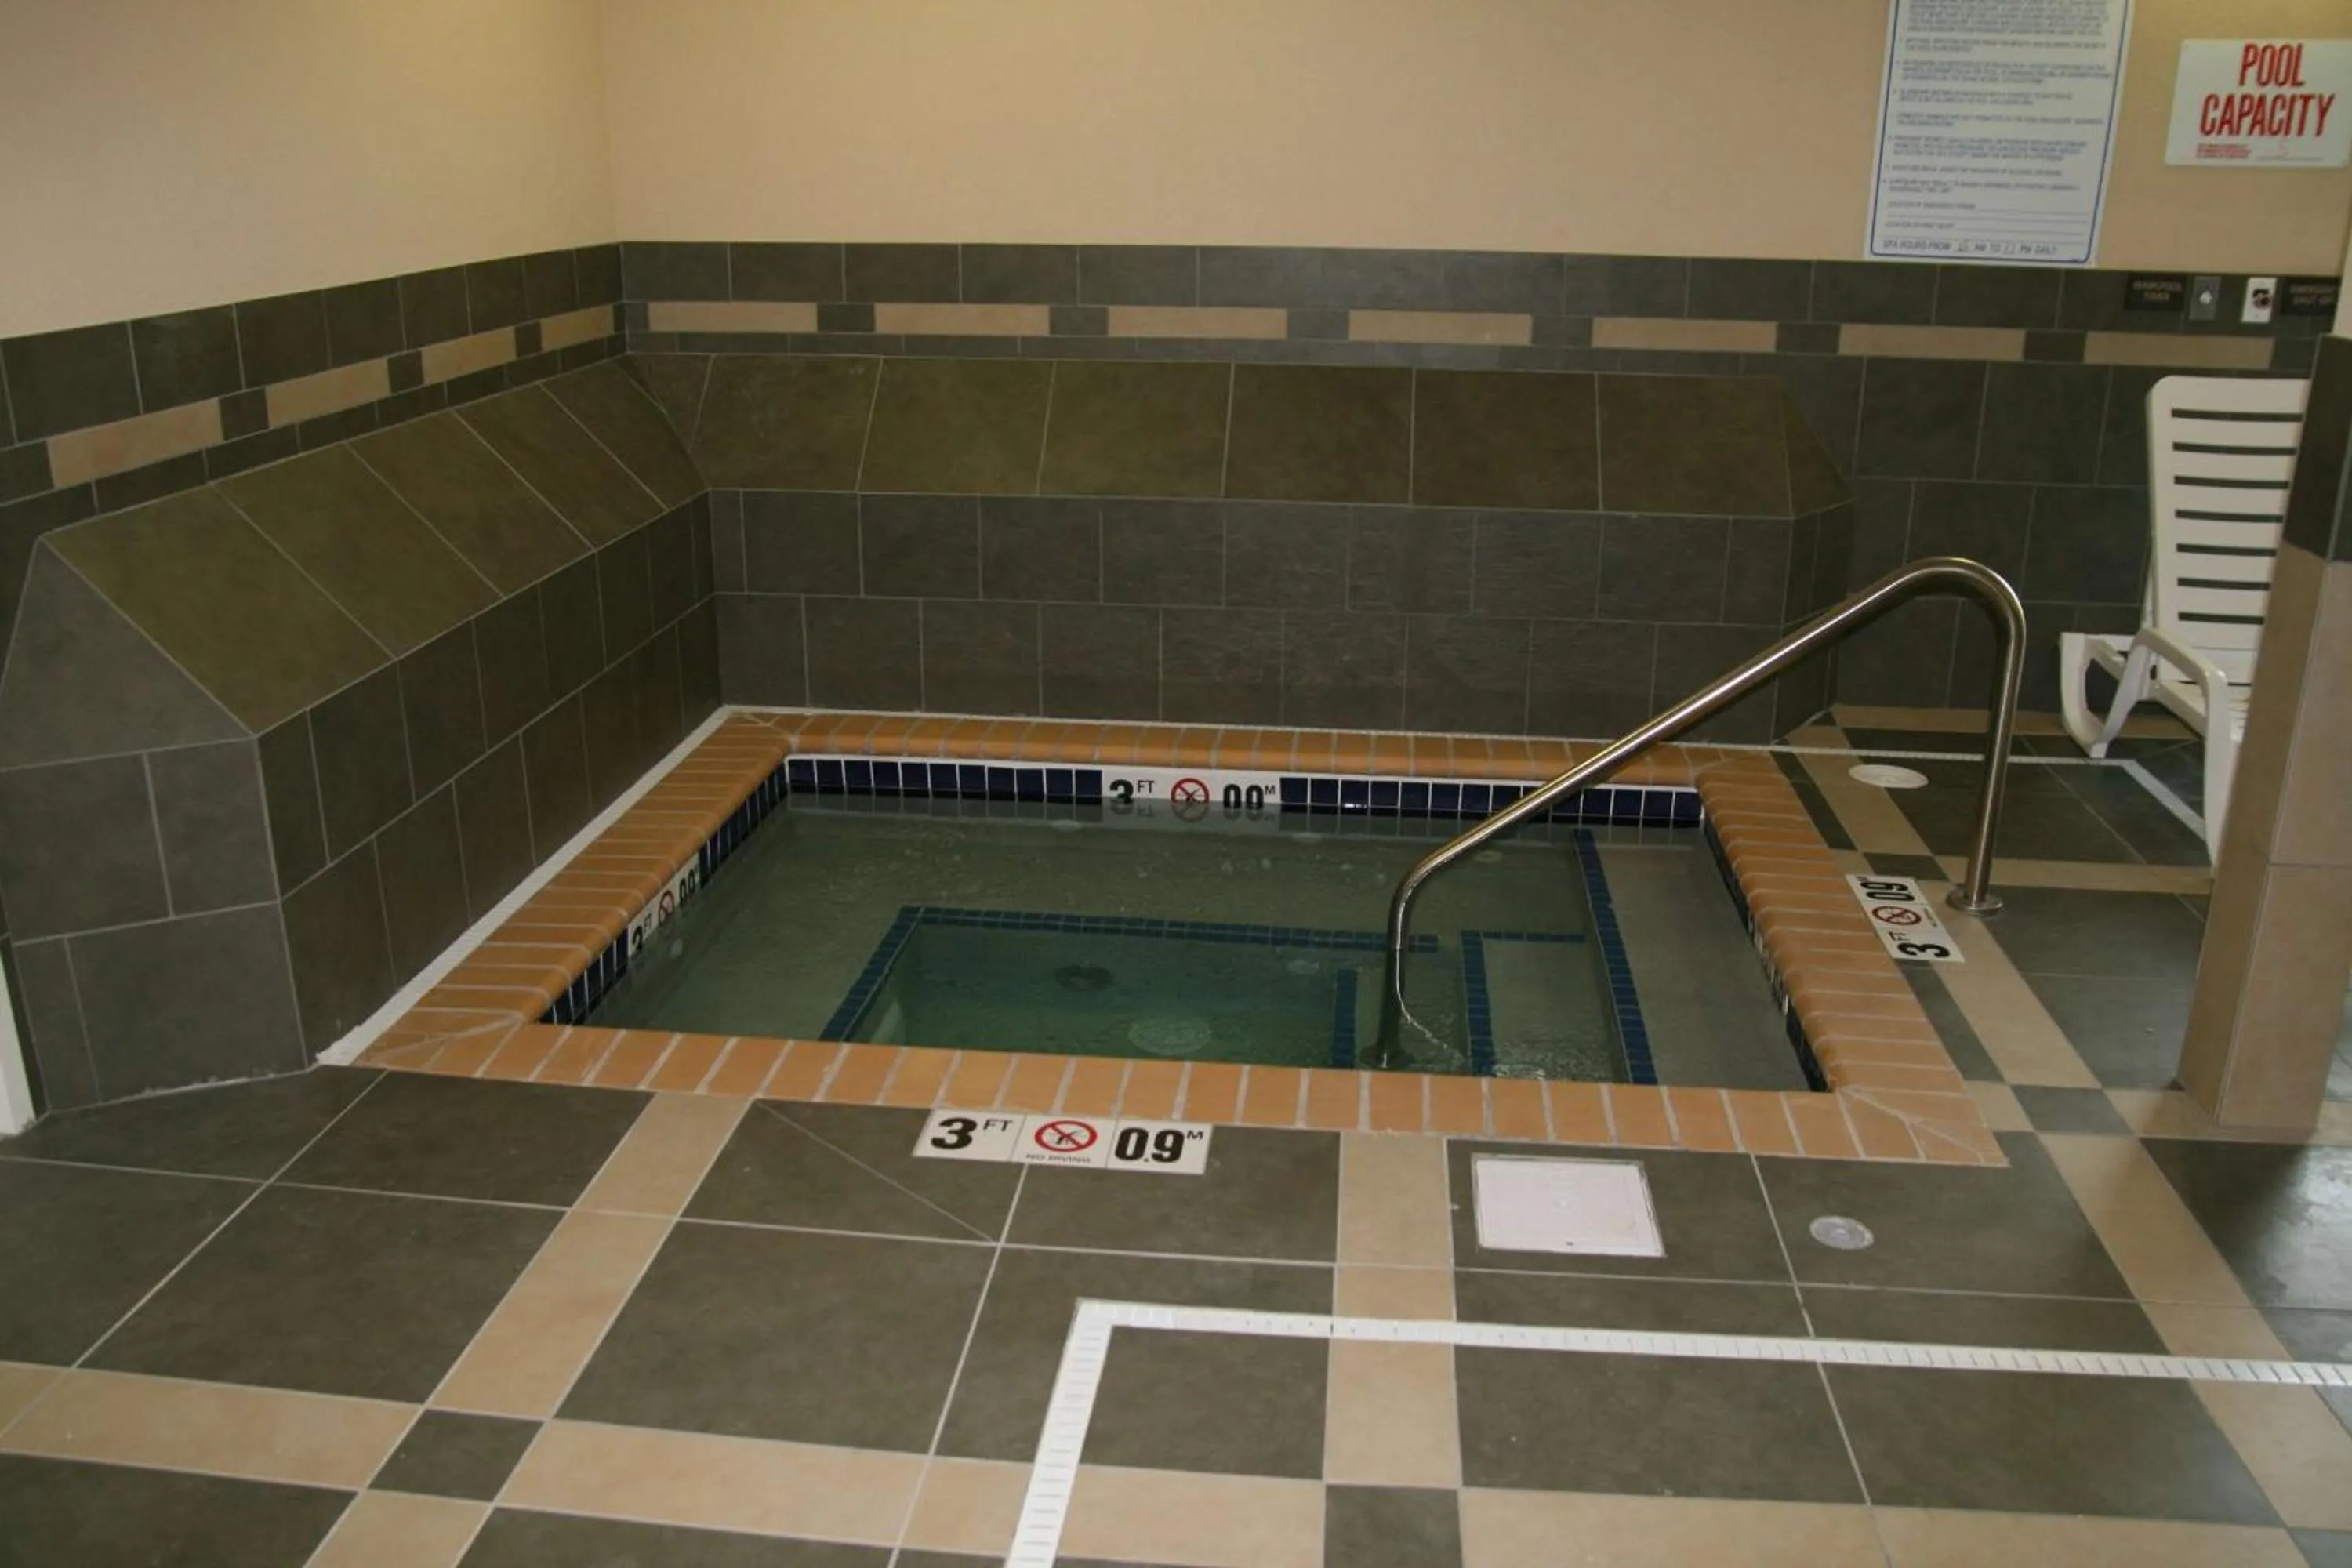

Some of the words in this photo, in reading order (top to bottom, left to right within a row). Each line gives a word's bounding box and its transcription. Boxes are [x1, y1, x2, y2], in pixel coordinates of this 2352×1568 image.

[2239, 43, 2305, 87] POOL
[2199, 93, 2336, 137] CAPACITY
[1897, 942, 1950, 957] 3
[931, 1118, 978, 1149] 3
[983, 1120, 1013, 1132] FT
[1114, 1127, 1186, 1163] 0.9
